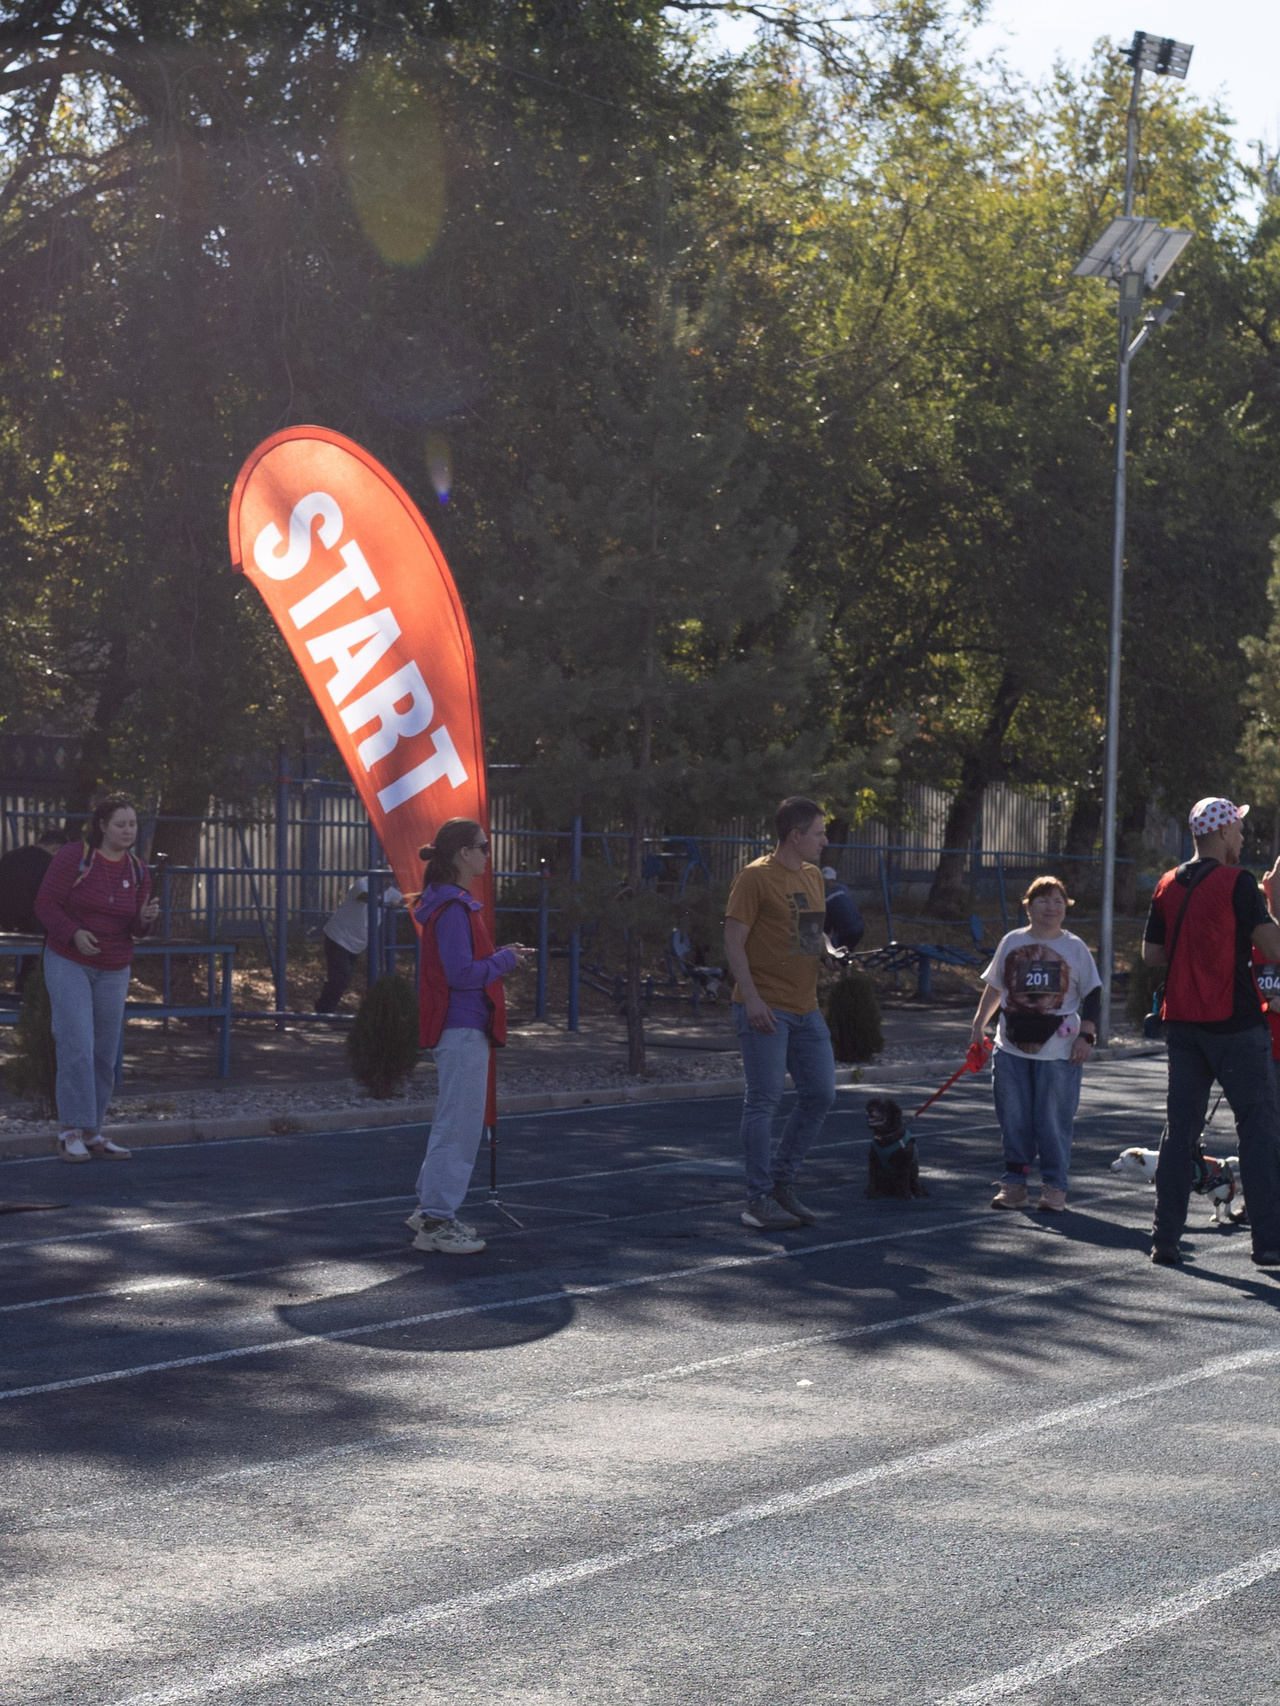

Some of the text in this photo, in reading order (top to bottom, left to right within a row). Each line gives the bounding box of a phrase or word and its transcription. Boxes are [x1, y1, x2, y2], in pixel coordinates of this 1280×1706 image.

[253, 491, 468, 813] START
[1025, 972, 1049, 986] 201
[1257, 976, 1280, 990] 204
